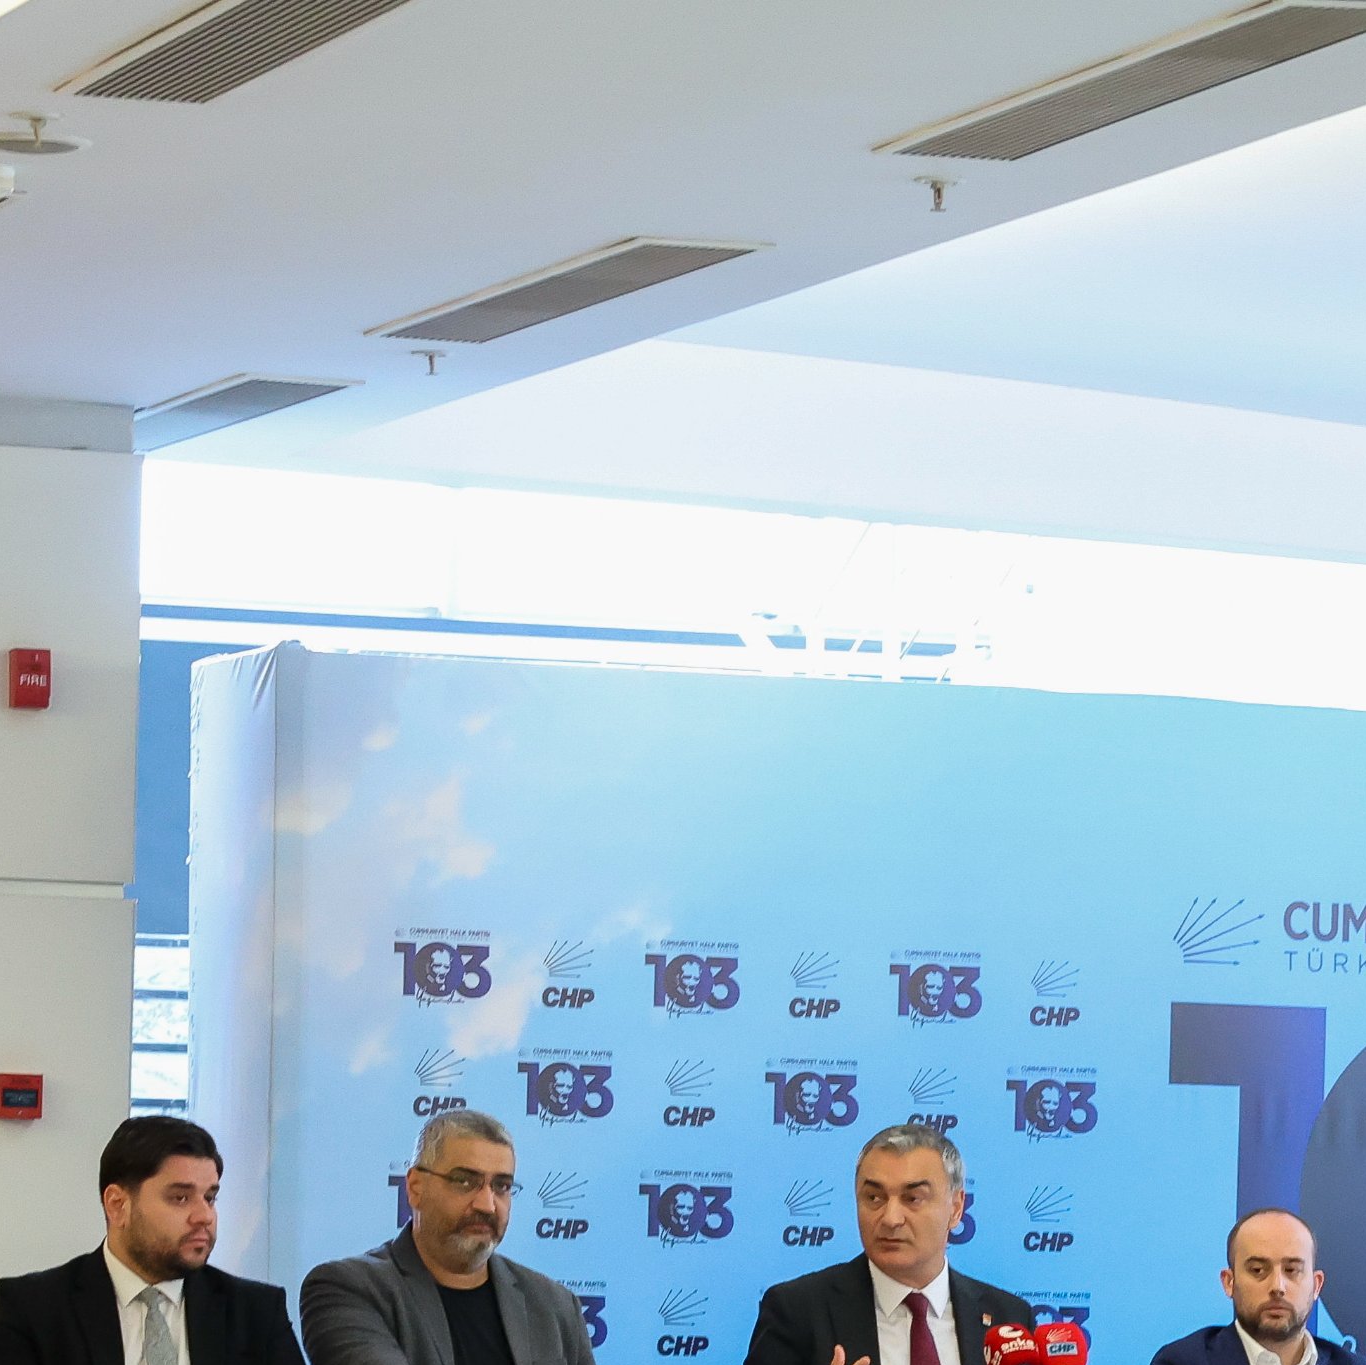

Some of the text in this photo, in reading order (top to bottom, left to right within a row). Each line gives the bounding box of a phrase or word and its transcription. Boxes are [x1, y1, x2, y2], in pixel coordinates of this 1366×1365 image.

[20, 673, 47, 687] FIRE
[394, 941, 491, 998] 103
[645, 954, 740, 1009] 103
[890, 964, 982, 1019] 103
[542, 987, 594, 1009] CHP
[789, 998, 840, 1018] CHP
[1030, 1006, 1080, 1027] CHP
[518, 1062, 613, 1118] 103
[765, 1072, 859, 1126] 103
[413, 1096, 466, 1117] CHP
[664, 1106, 715, 1127] CHP
[1006, 1079, 1098, 1133] 103
[639, 1184, 734, 1239] 103
[536, 1218, 589, 1239] CHP
[783, 1225, 834, 1247] CHP
[1024, 1232, 1073, 1252] CHP
[657, 1335, 709, 1357] CHP
[1049, 1343, 1075, 1354] CHP
